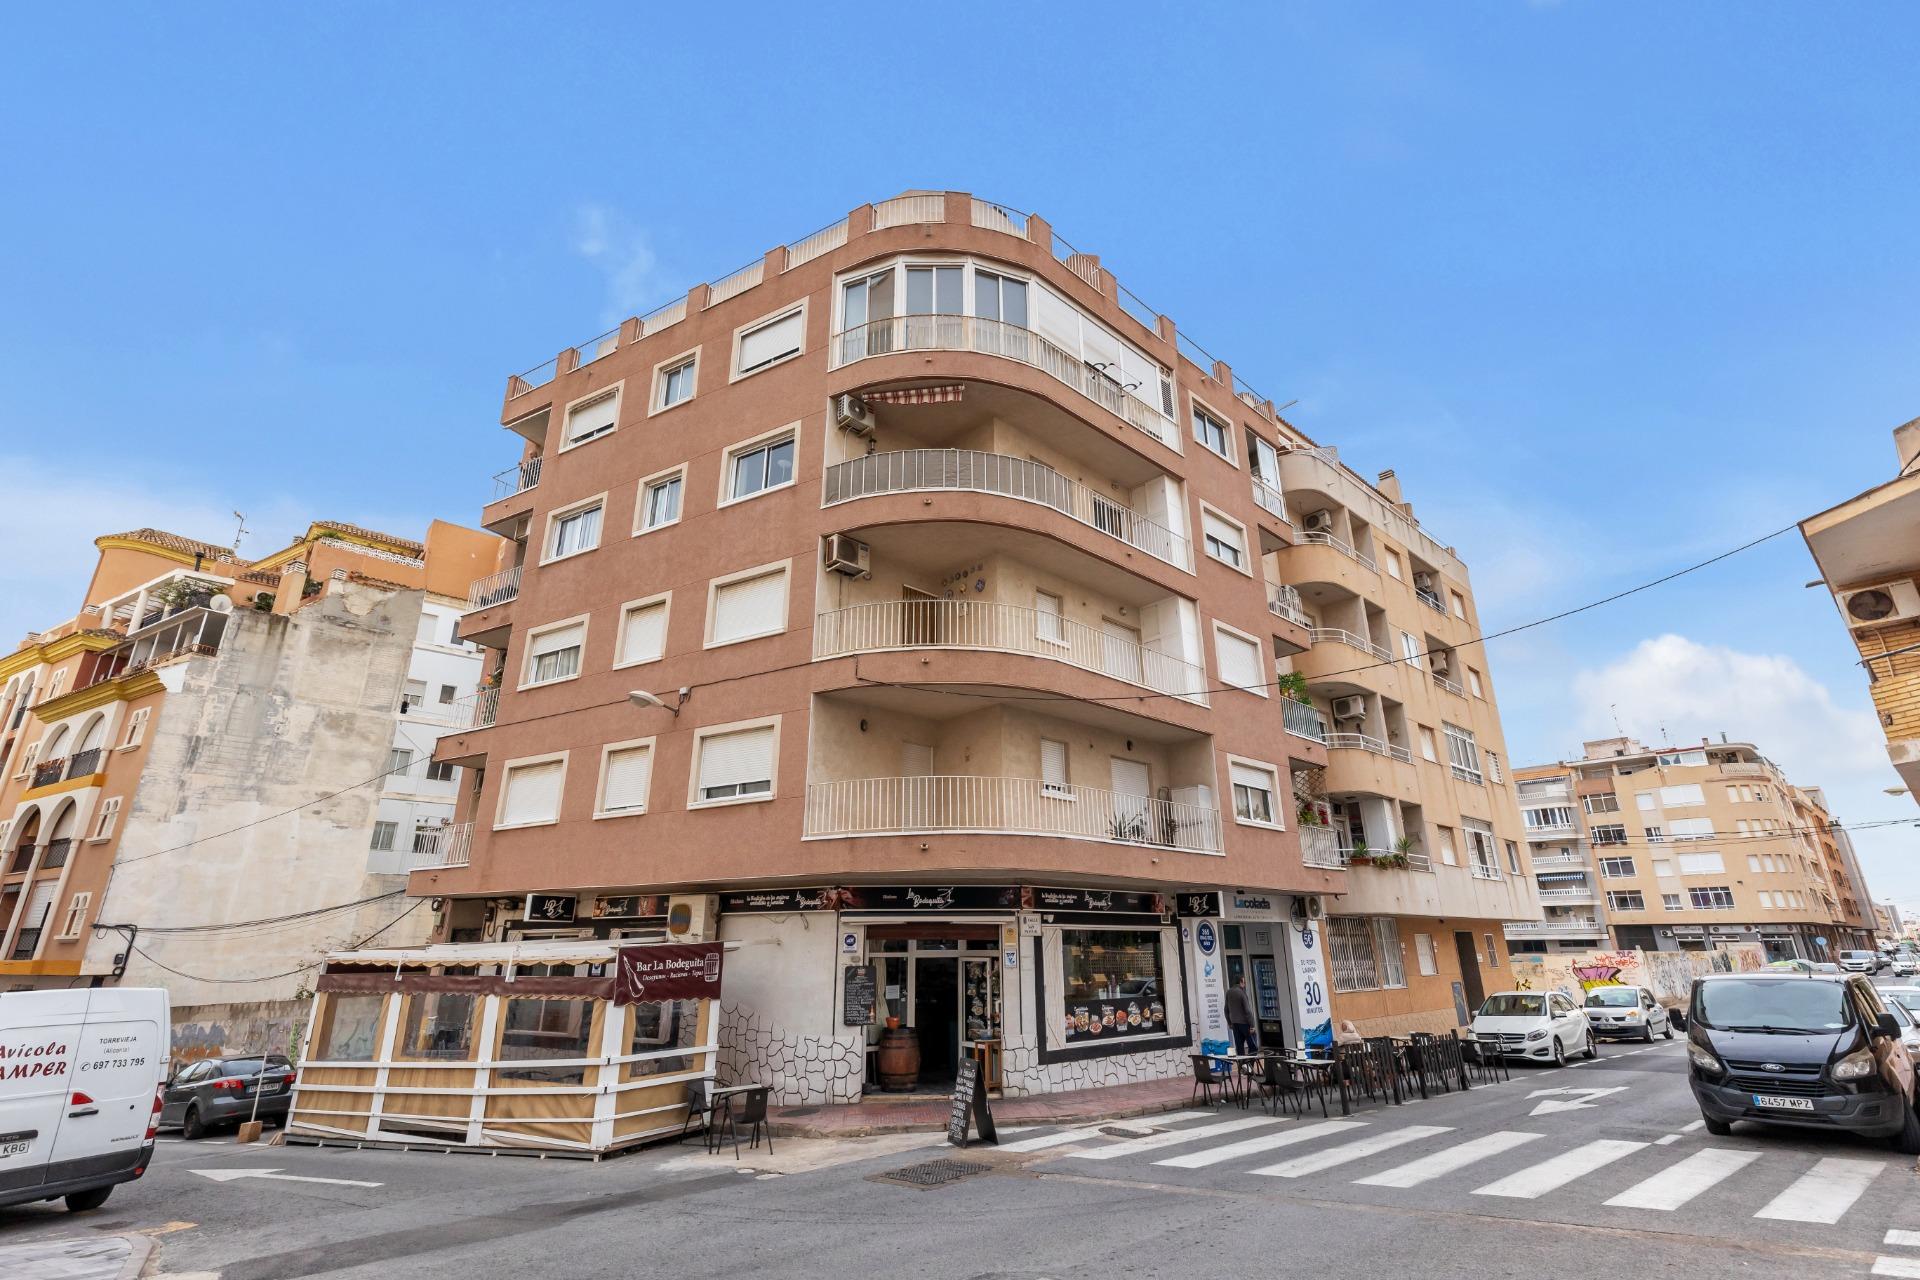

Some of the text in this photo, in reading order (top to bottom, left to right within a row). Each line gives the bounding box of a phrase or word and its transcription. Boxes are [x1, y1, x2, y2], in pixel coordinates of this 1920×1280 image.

[636, 957, 704, 972] Bar La Bodeguita
[1304, 981, 1321, 1006] 30
[1306, 1006, 1324, 1014] MINUTOS
[99, 1036, 137, 1044] TORREVIEJA
[93, 1057, 145, 1070] 697 733 795
[1760, 1098, 1811, 1108] 6457 MPZ
[3, 1143, 27, 1155] KBG
